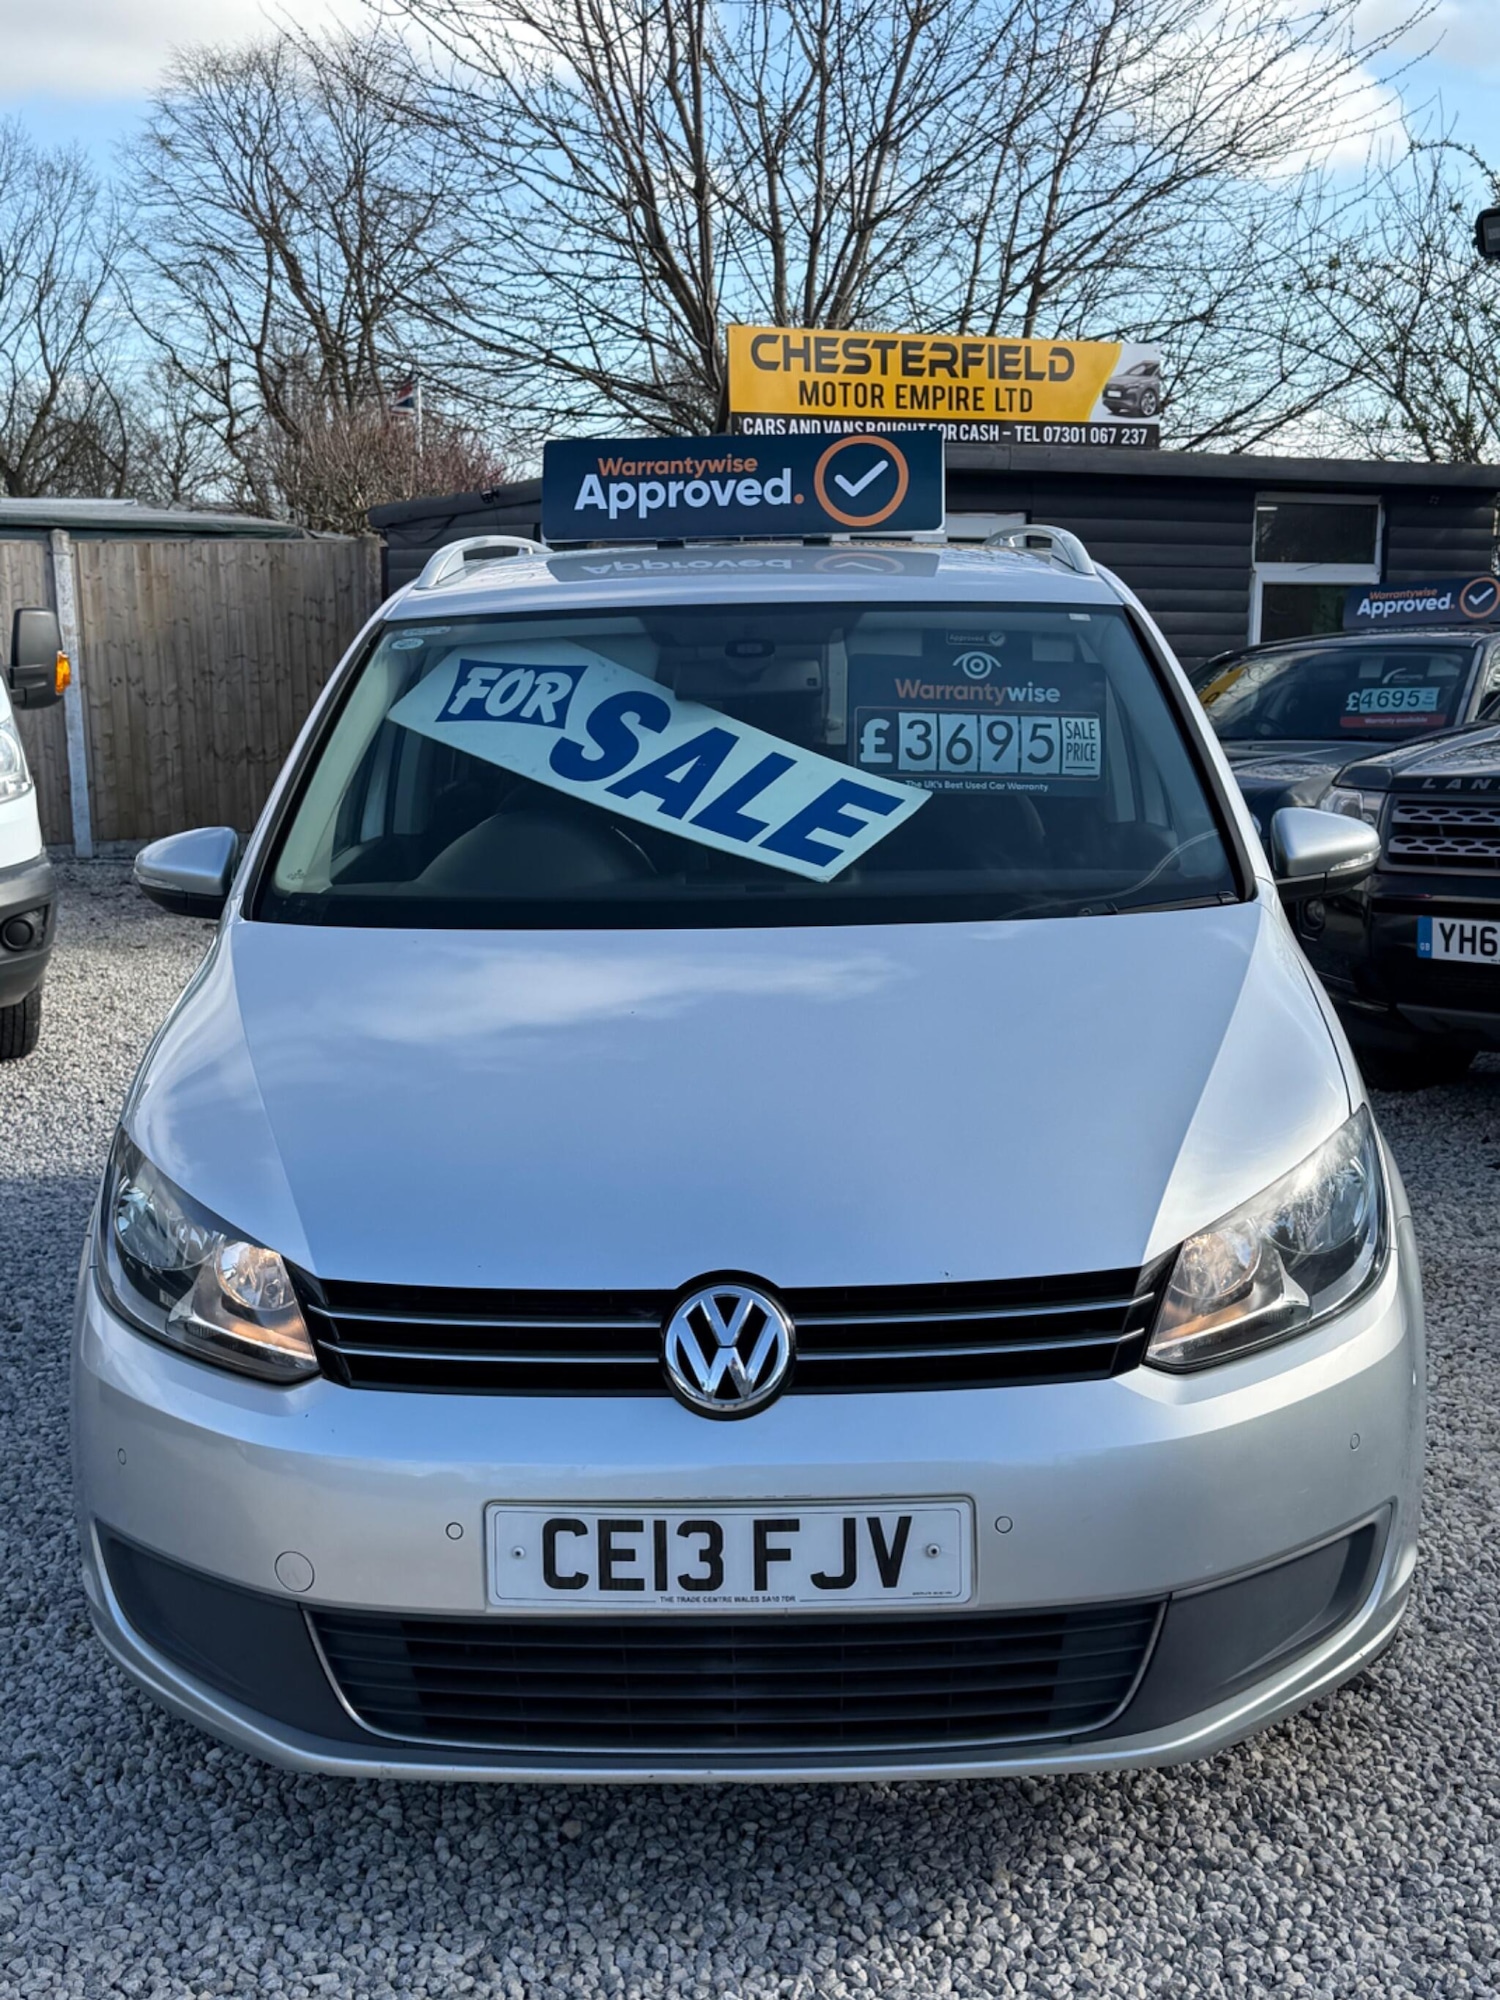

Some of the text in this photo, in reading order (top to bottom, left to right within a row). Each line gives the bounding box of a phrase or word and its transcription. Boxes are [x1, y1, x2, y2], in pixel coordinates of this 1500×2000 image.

[751, 333, 1075, 382] CHESTERFIELD
[799, 380, 1033, 413] MOTOR EMPIRE LTD
[743, 417, 786, 435] CARS
[788, 419, 821, 434] AND
[823, 420, 863, 433] VANS
[960, 424, 999, 441] CASH
[1015, 425, 1040, 442] TEL
[1043, 426, 1086, 443] 07301
[1090, 427, 1116, 444] 067
[1121, 428, 1147, 444] 237
[598, 453, 758, 478] Warrantywise
[574, 468, 804, 519] Approved.
[1357, 592, 1455, 619] Approved.
[1370, 587, 1437, 601] Warrantywise
[895, 678, 1061, 705] Warrantywise
[1346, 690, 1421, 711] £4695
[1065, 720, 1096, 740] SALE
[1065, 743, 1096, 762] PRICE
[447, 665, 906, 868] FOR SALE
[924, 780, 942, 789] UK's
[944, 781, 963, 789] Best
[966, 781, 987, 789] Used
[989, 782, 1005, 790] Car
[1007, 782, 1049, 792] Warranty
[1422, 778, 1500, 790] LAN
[1439, 922, 1498, 957] YH6
[542, 1515, 912, 1591] CE13 FJV
